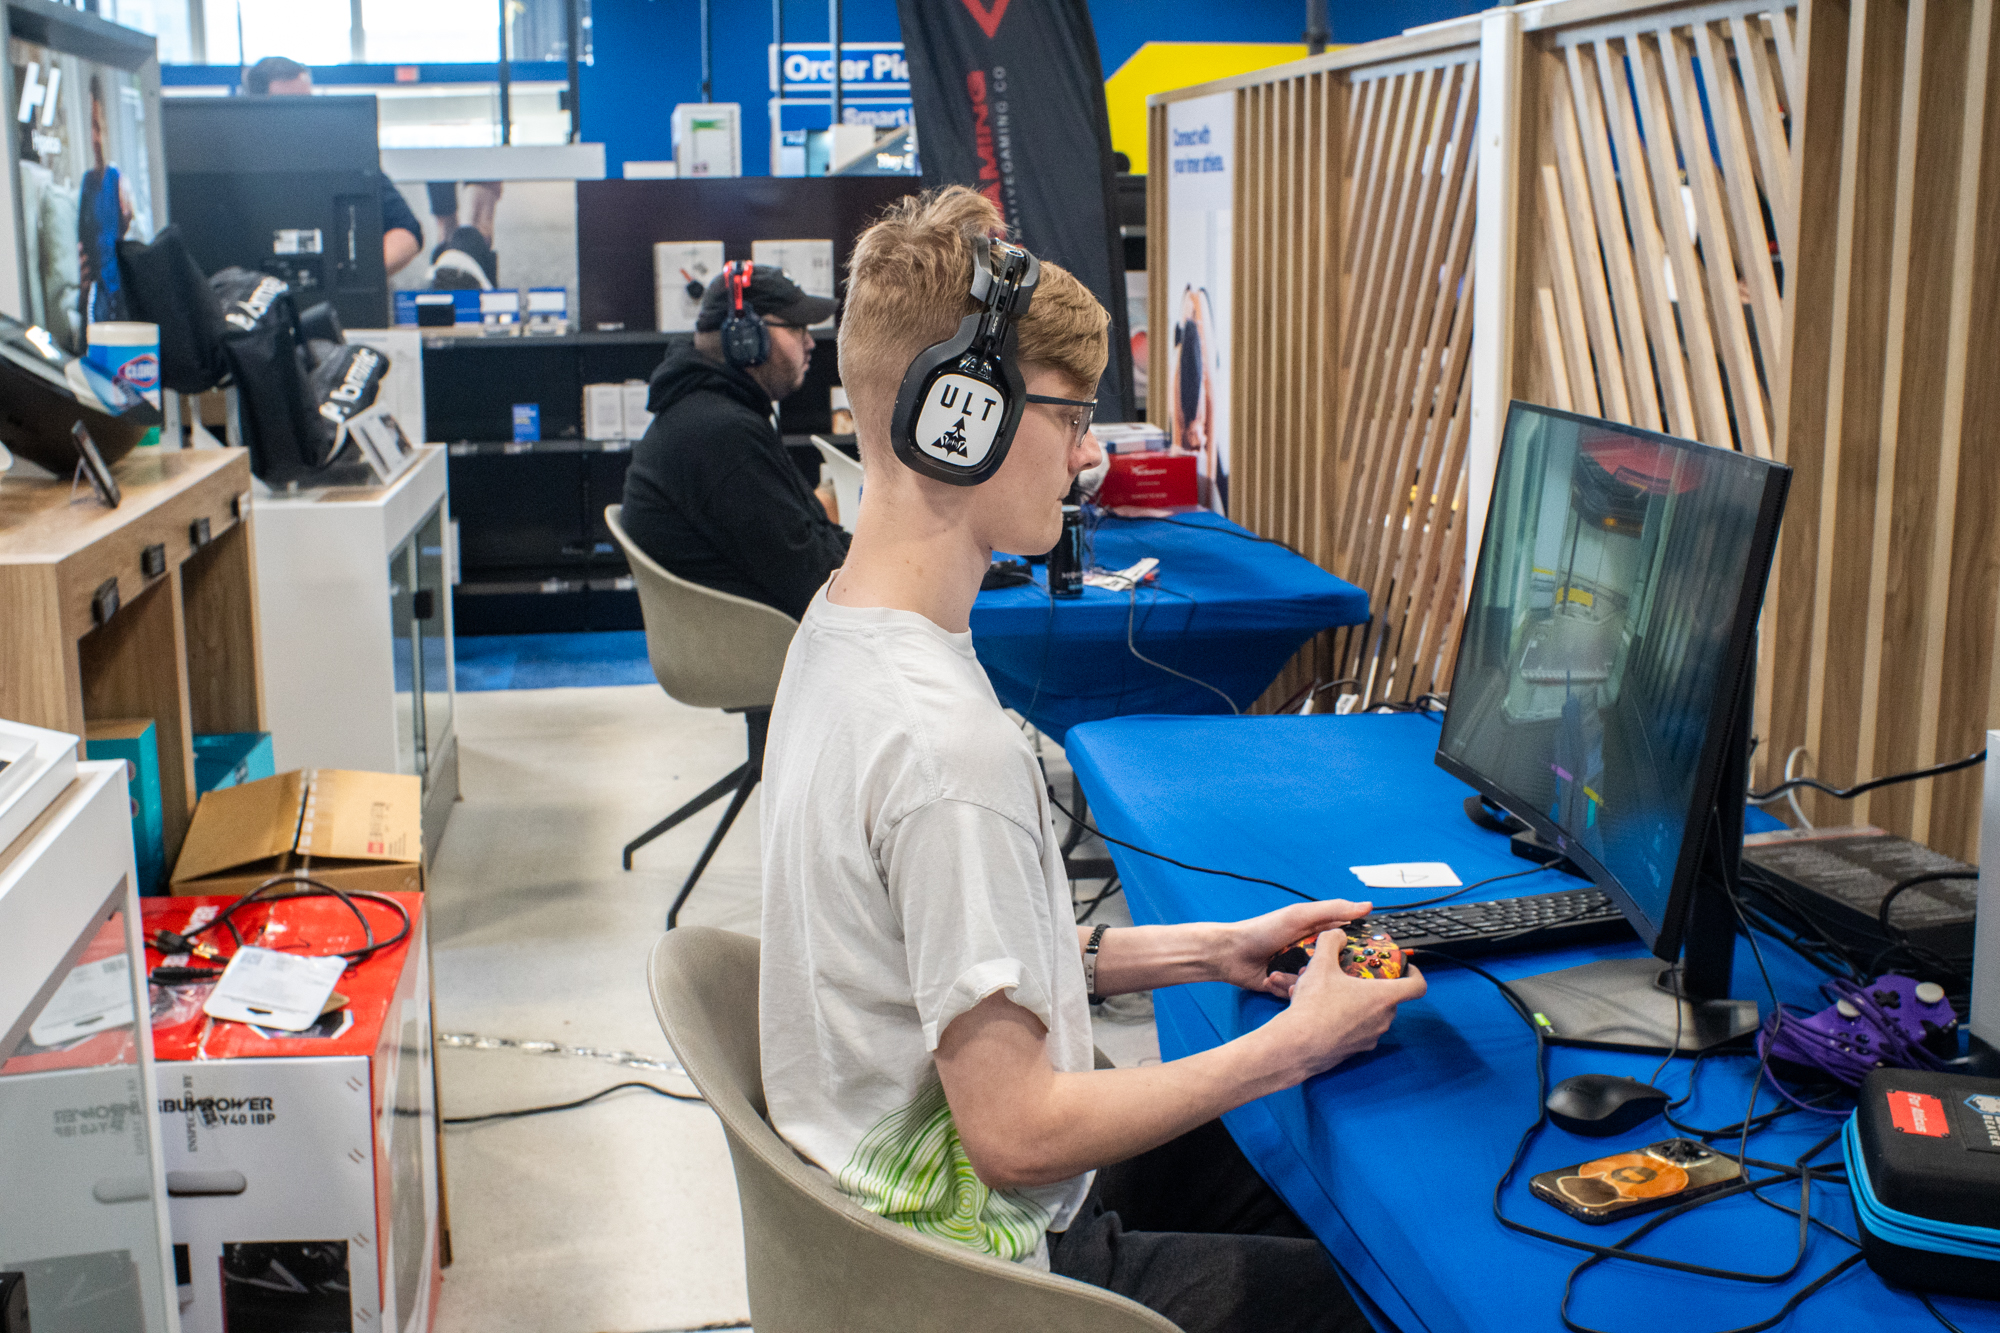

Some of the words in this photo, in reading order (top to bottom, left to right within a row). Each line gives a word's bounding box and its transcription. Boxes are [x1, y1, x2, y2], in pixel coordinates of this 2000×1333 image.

[940, 383, 997, 421] ULT
[220, 1113, 248, 1125] Y40
[251, 1112, 276, 1125] IBP
